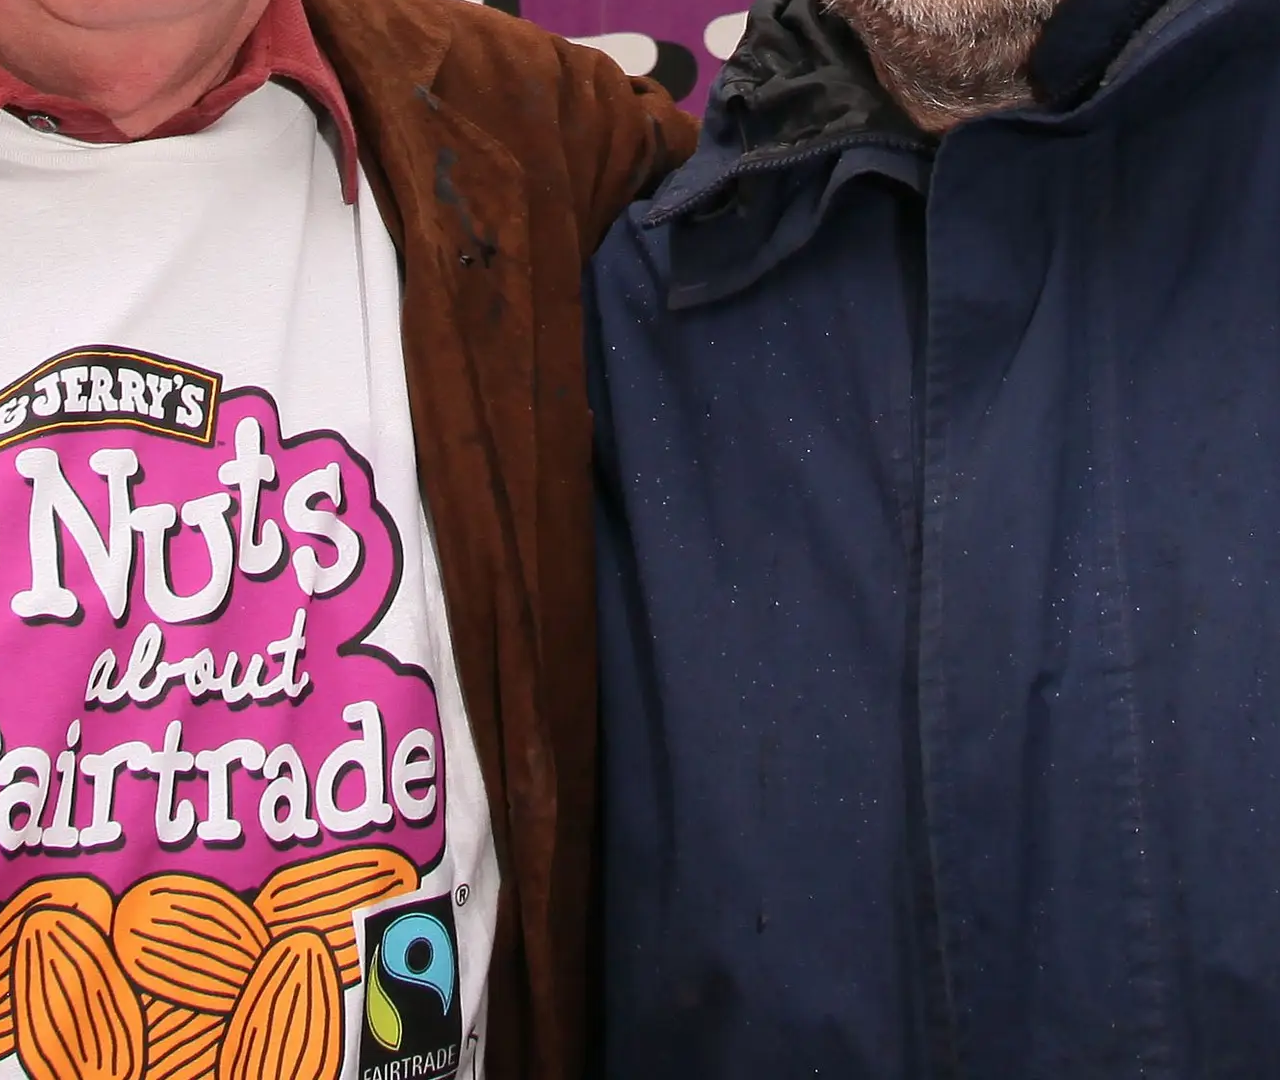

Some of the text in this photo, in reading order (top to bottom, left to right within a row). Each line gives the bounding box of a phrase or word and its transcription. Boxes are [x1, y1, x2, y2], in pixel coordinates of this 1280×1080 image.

[32, 366, 205, 428] JERRY'S
[10, 416, 361, 622] Nuts
[84, 607, 310, 704] about
